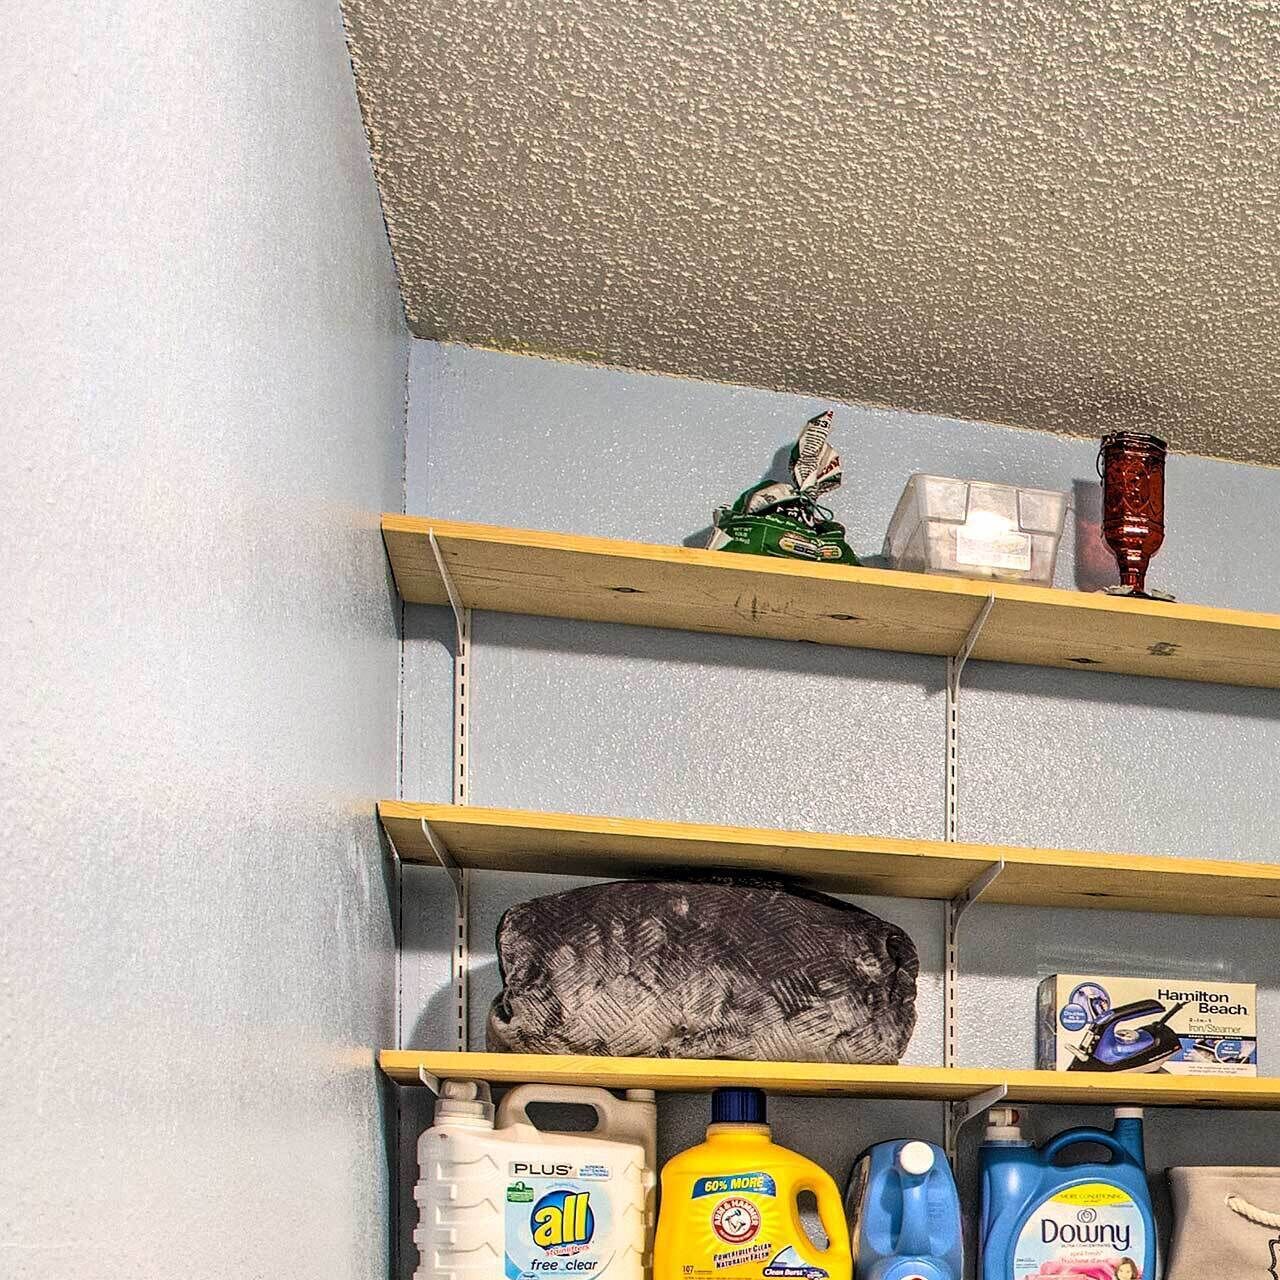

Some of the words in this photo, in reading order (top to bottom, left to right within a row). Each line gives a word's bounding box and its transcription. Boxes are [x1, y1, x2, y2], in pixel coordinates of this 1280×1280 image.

[1158, 989, 1229, 1003] Hamilton
[1199, 1002, 1248, 1016] Beach
[1188, 1024, 1241, 1034] Iron/Steamer
[704, 1180, 728, 1192] 60%
[731, 1176, 764, 1190] MORE
[533, 1191, 590, 1247] all
[1041, 1218, 1130, 1252] Downy
[531, 1259, 558, 1271] free
[565, 1259, 598, 1271] clear
[764, 1268, 784, 1276] Clean
[784, 1268, 803, 1276] Burst
